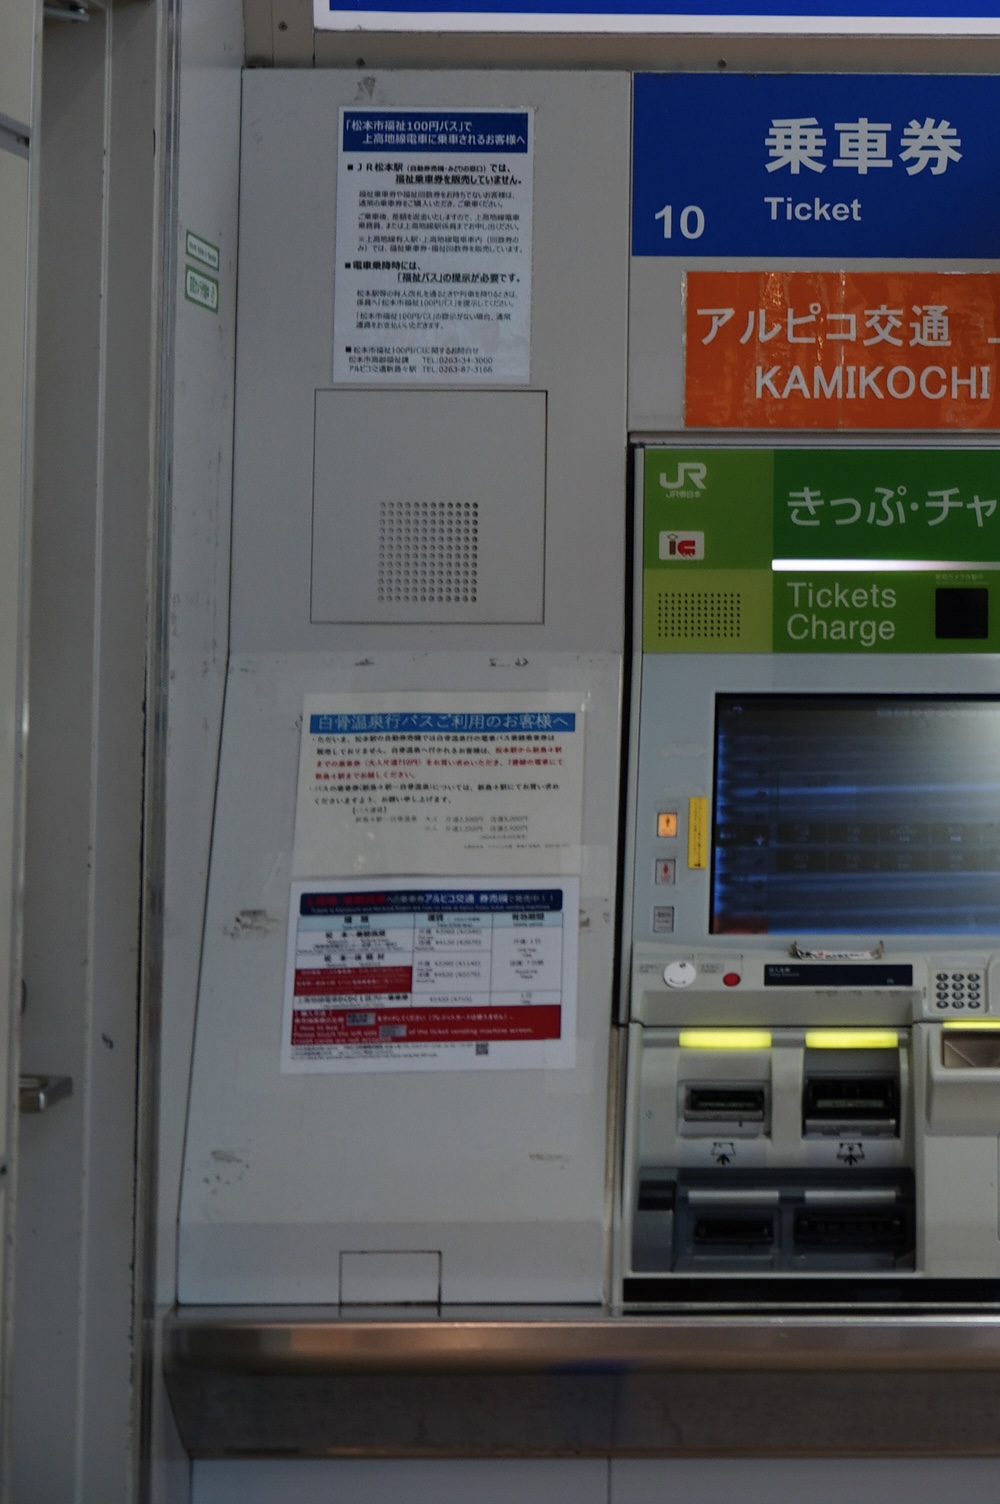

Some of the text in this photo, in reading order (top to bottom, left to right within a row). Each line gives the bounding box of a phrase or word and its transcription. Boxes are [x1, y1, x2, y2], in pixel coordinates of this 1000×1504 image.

[765, 117, 962, 175] 乗車券
[655, 205, 704, 239] 10
[764, 197, 861, 221] Ticket
[697, 303, 951, 347] アルピコ交通
[756, 366, 990, 399] KAMIKOCHI
[660, 463, 706, 489] JR
[787, 582, 896, 608] Tickets
[787, 614, 895, 647] Charge
